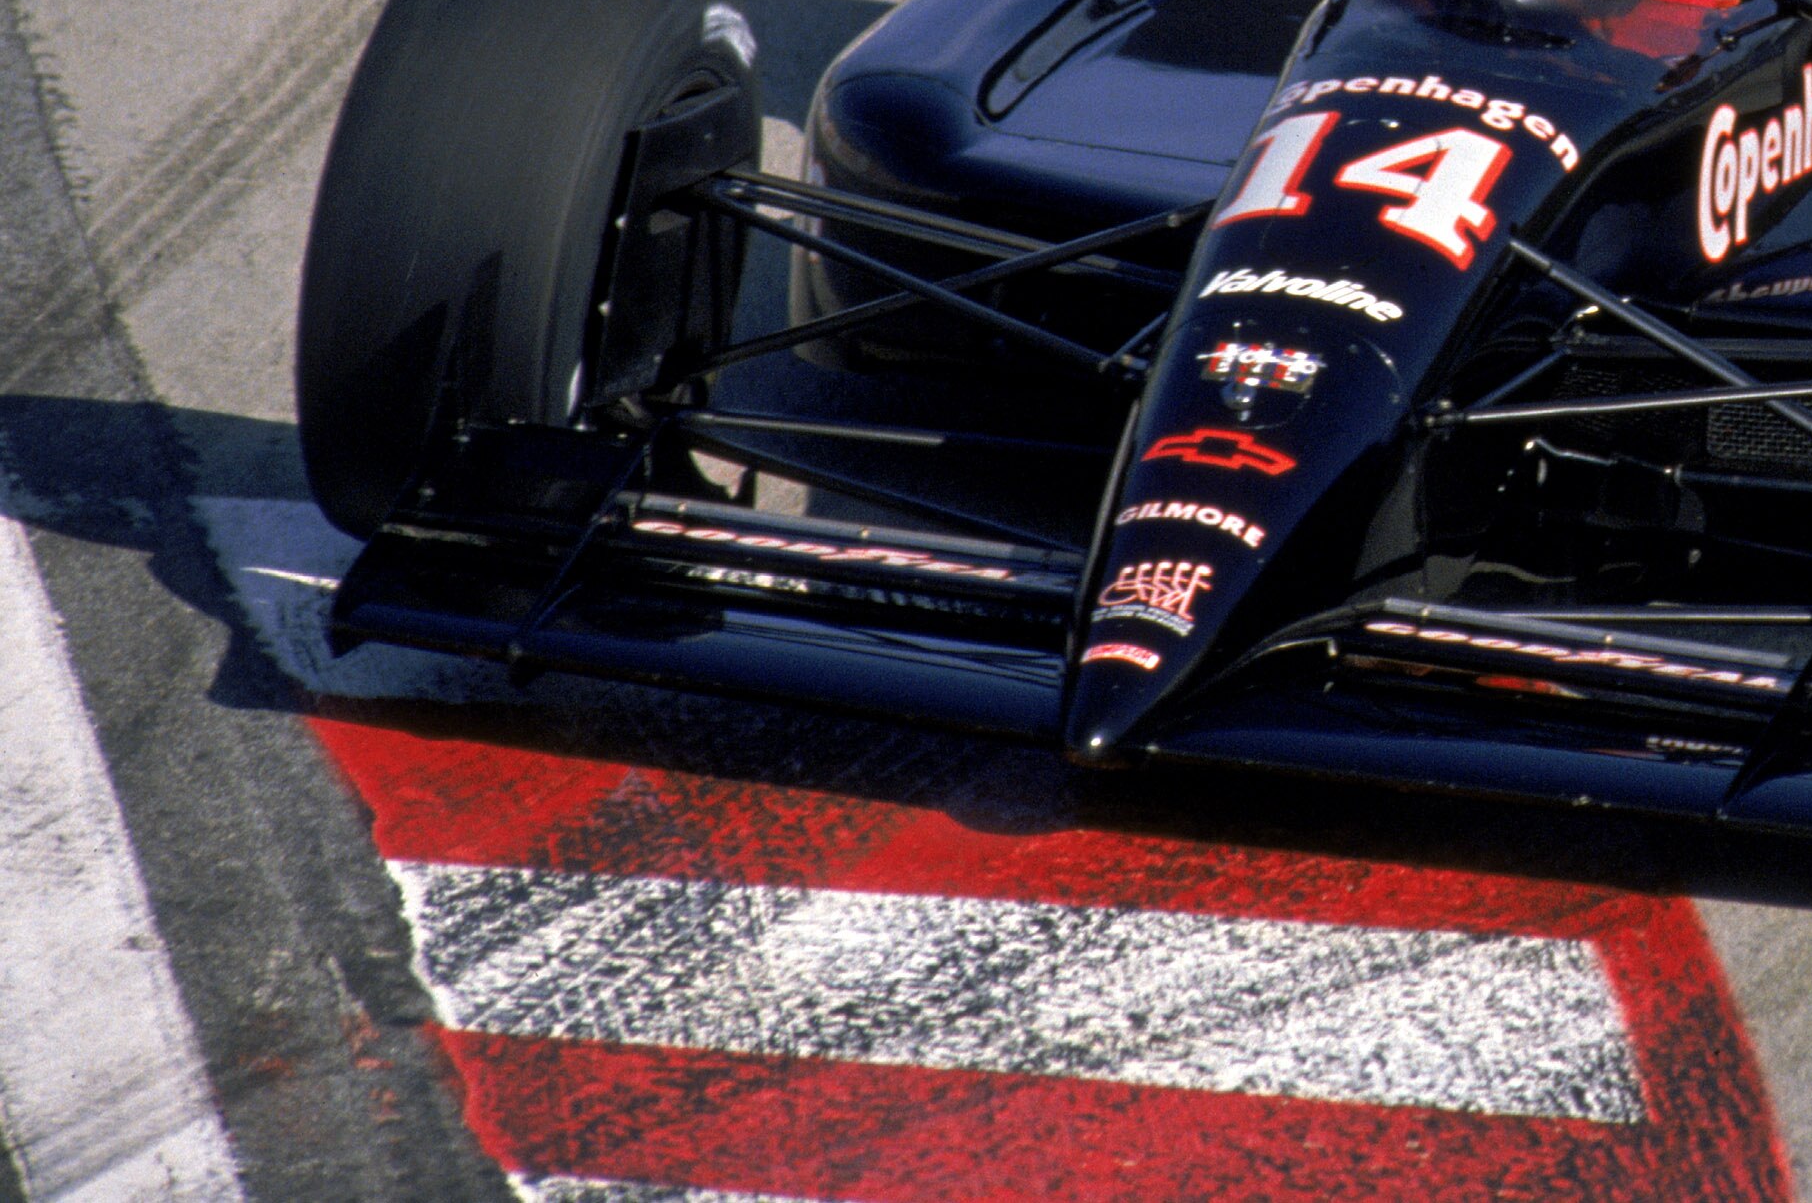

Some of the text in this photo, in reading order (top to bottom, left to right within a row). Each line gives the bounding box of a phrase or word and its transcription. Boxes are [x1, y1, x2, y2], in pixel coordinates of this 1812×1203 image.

[1211, 110, 1514, 272] 14
[1199, 267, 1404, 323] Valvoline
[1114, 500, 1266, 550] GILMORE
[1364, 621, 1781, 689] GOODYEAR
